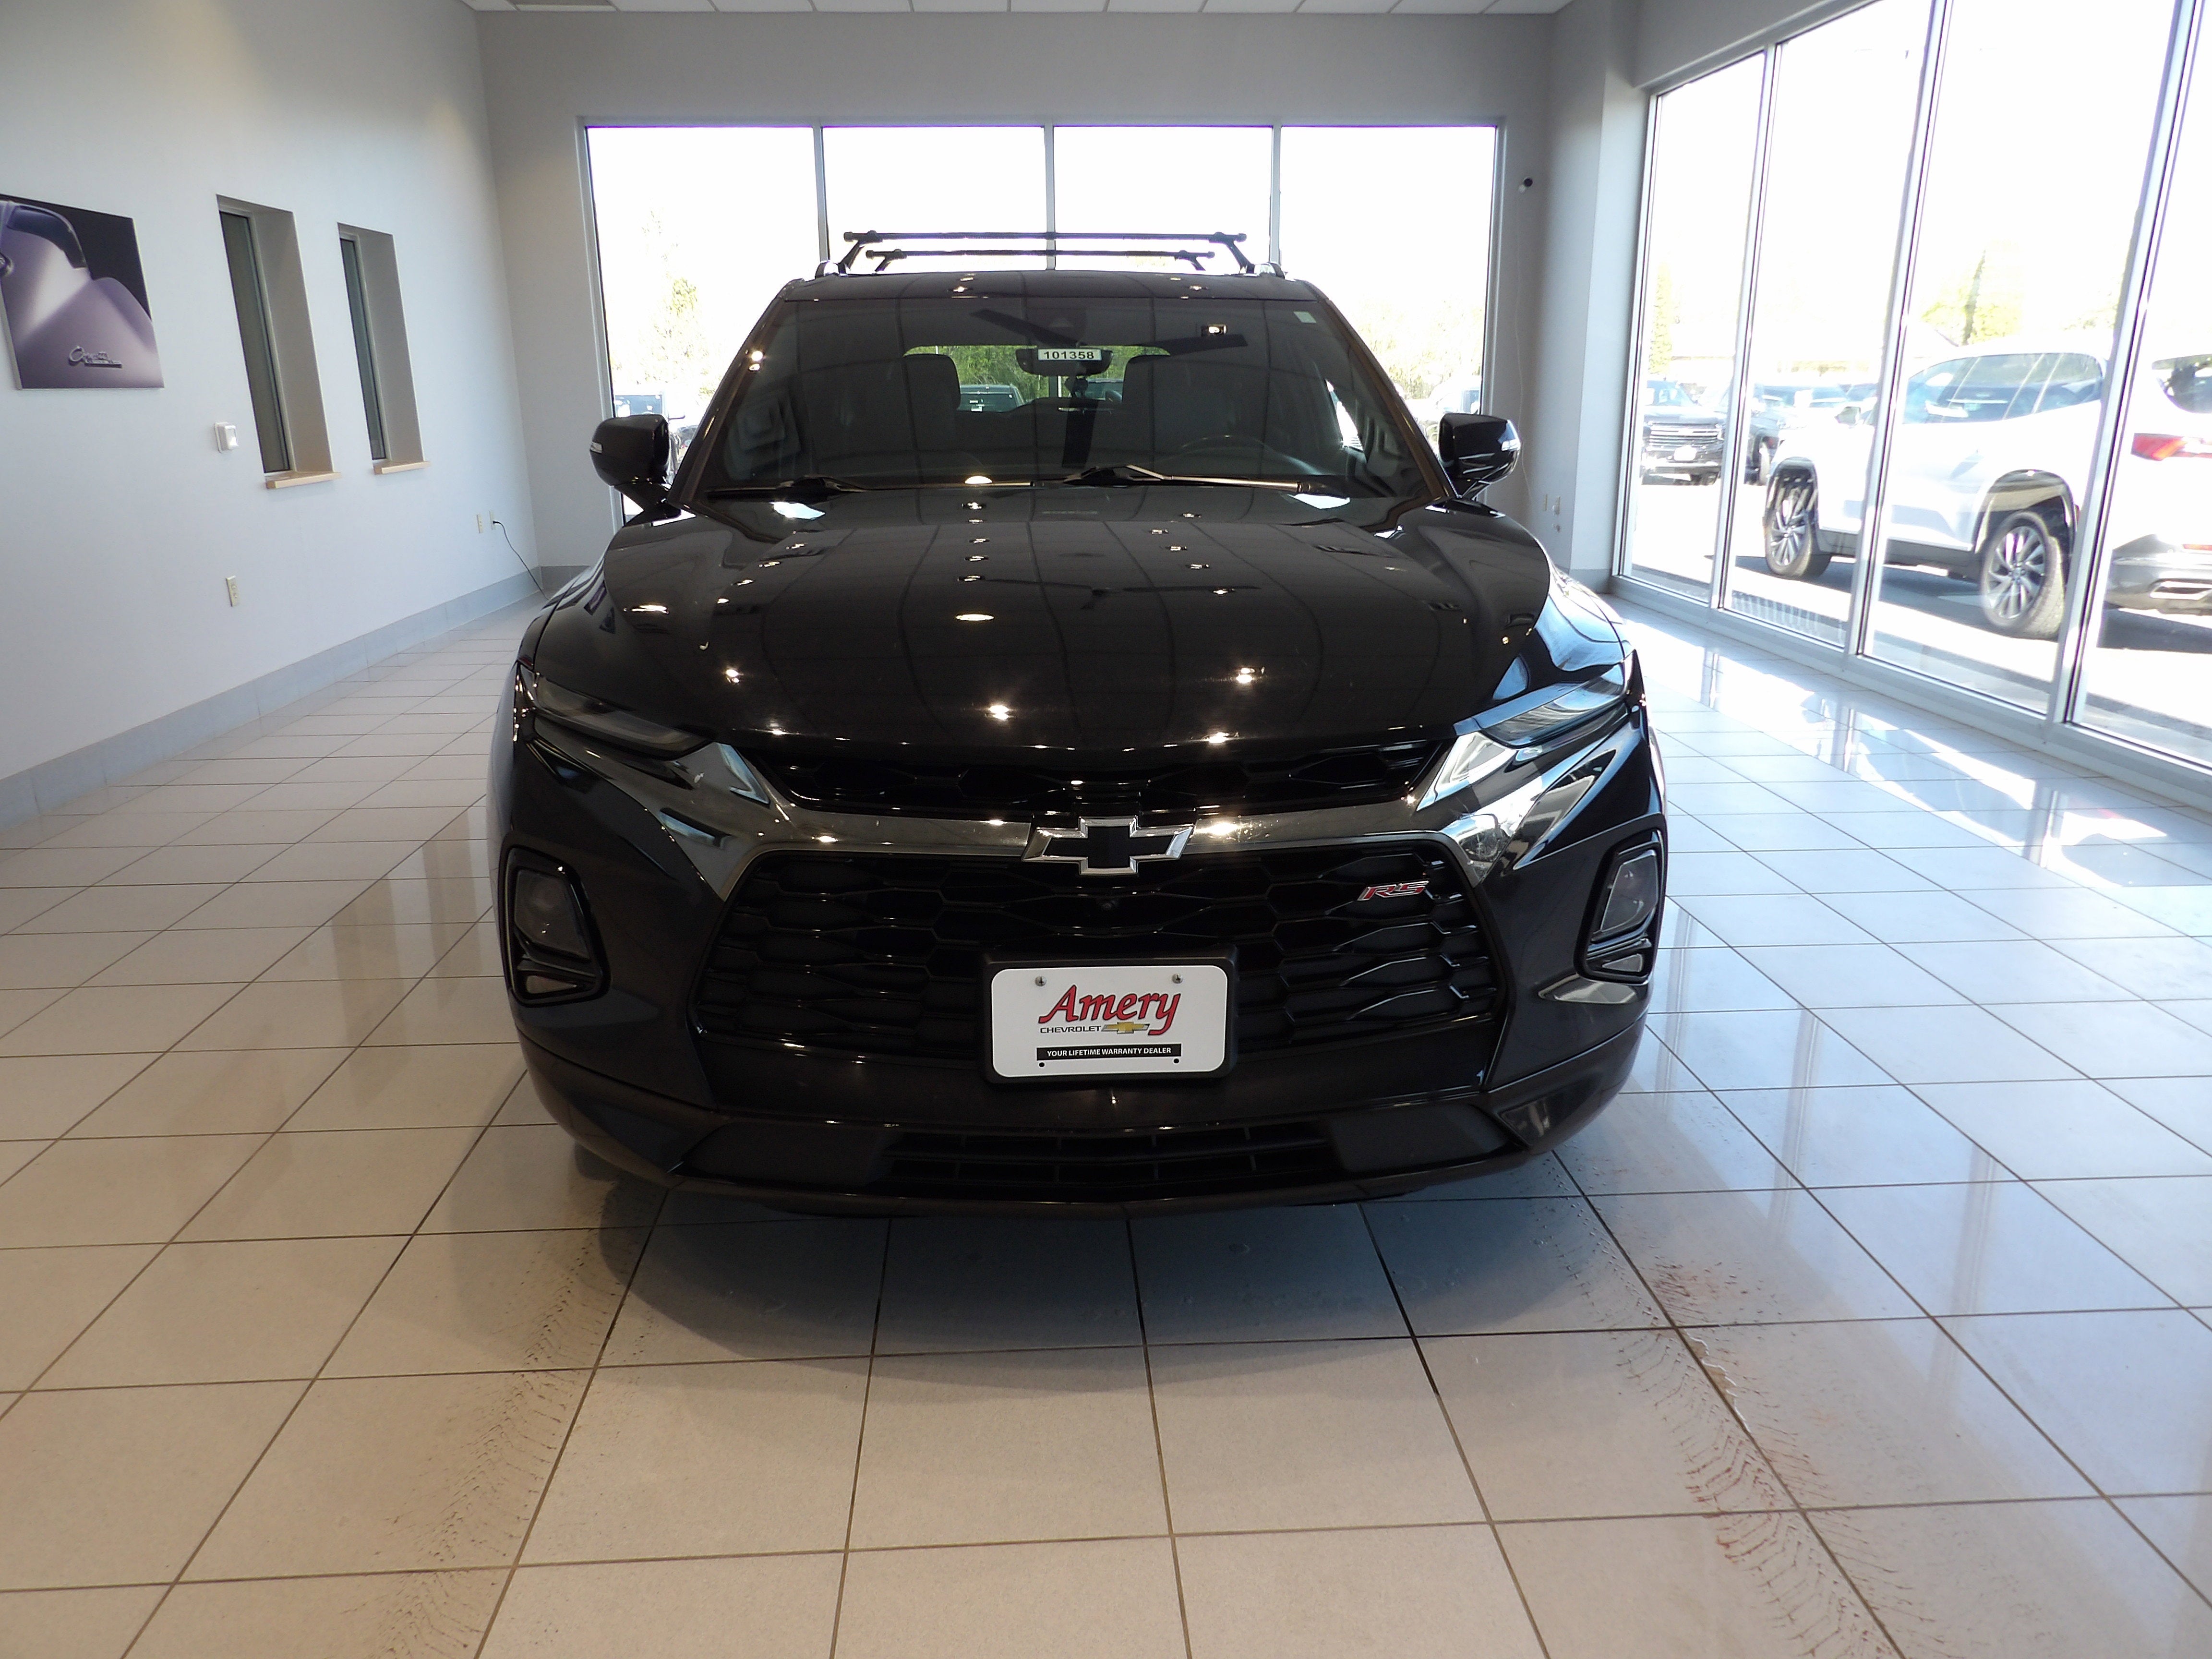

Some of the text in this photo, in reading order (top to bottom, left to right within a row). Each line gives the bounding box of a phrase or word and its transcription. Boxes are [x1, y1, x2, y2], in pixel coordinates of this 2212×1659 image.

[1044, 351, 1094, 359] 101358
[1357, 880, 1430, 901] RS
[1038, 984, 1181, 1036] Amery
[1040, 1025, 1101, 1034] CHEVROLET
